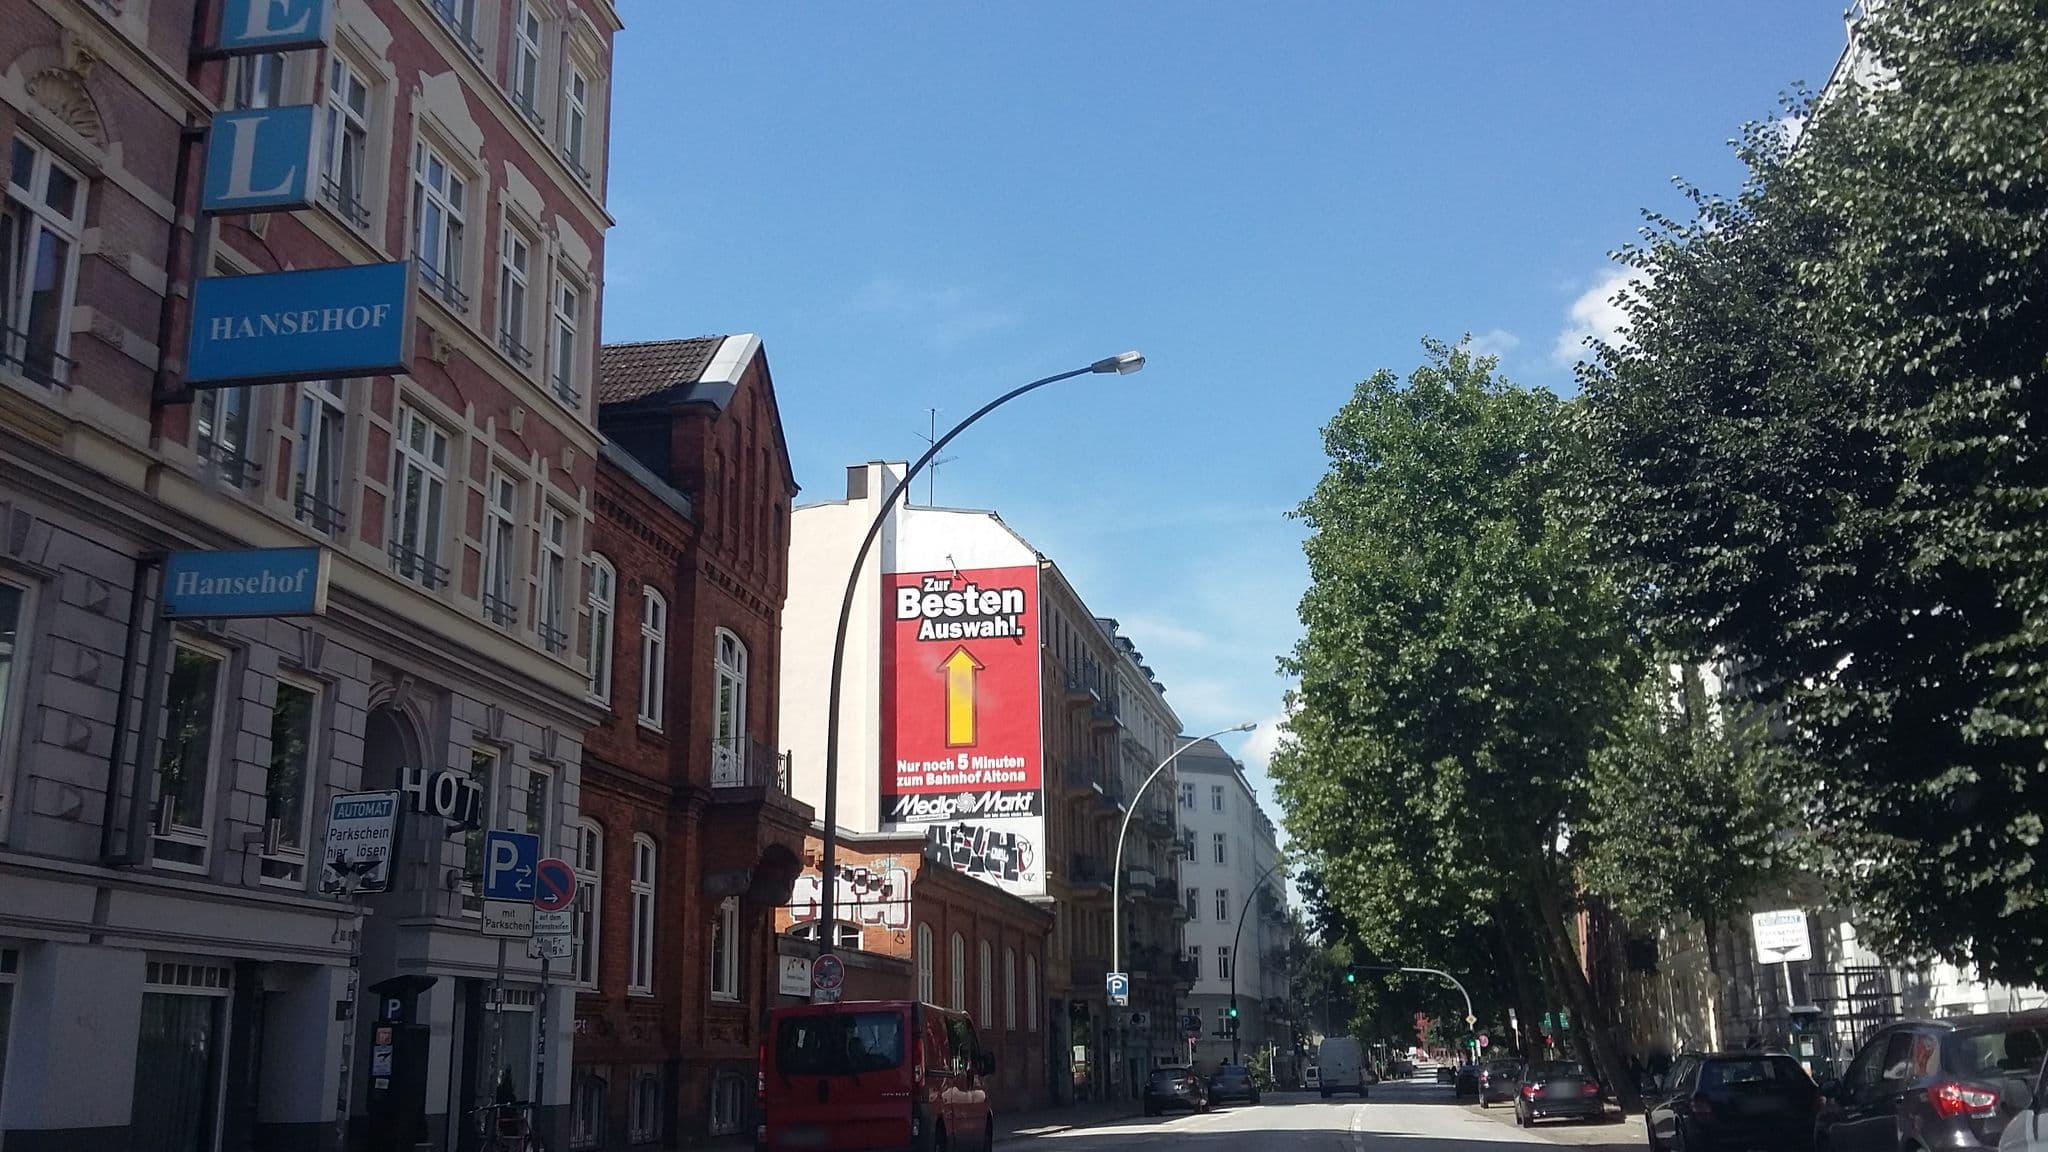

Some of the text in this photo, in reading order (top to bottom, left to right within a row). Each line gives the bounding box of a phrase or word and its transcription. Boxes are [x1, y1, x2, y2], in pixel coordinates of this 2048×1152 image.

[210, 304, 391, 341] HANSEHOF
[175, 567, 309, 596] Hansehof
[924, 578, 950, 592] Zur
[897, 584, 1024, 619] Besten
[919, 614, 1023, 640] Auswahl.
[897, 753, 1025, 774] Nur noch 5 Minuten
[896, 769, 1026, 787] zum Bahnhof Altona
[402, 766, 483, 826] HOT
[891, 791, 1034, 816] Media Markt
[337, 801, 390, 818] AUTOMAT
[329, 826, 389, 842] Parkschein
[326, 843, 387, 860] hier lösen
[488, 839, 519, 890] P
[502, 909, 515, 918] mit
[485, 918, 530, 930] Parkschein
[1112, 980, 1122, 993] P
[388, 999, 401, 1018] P
